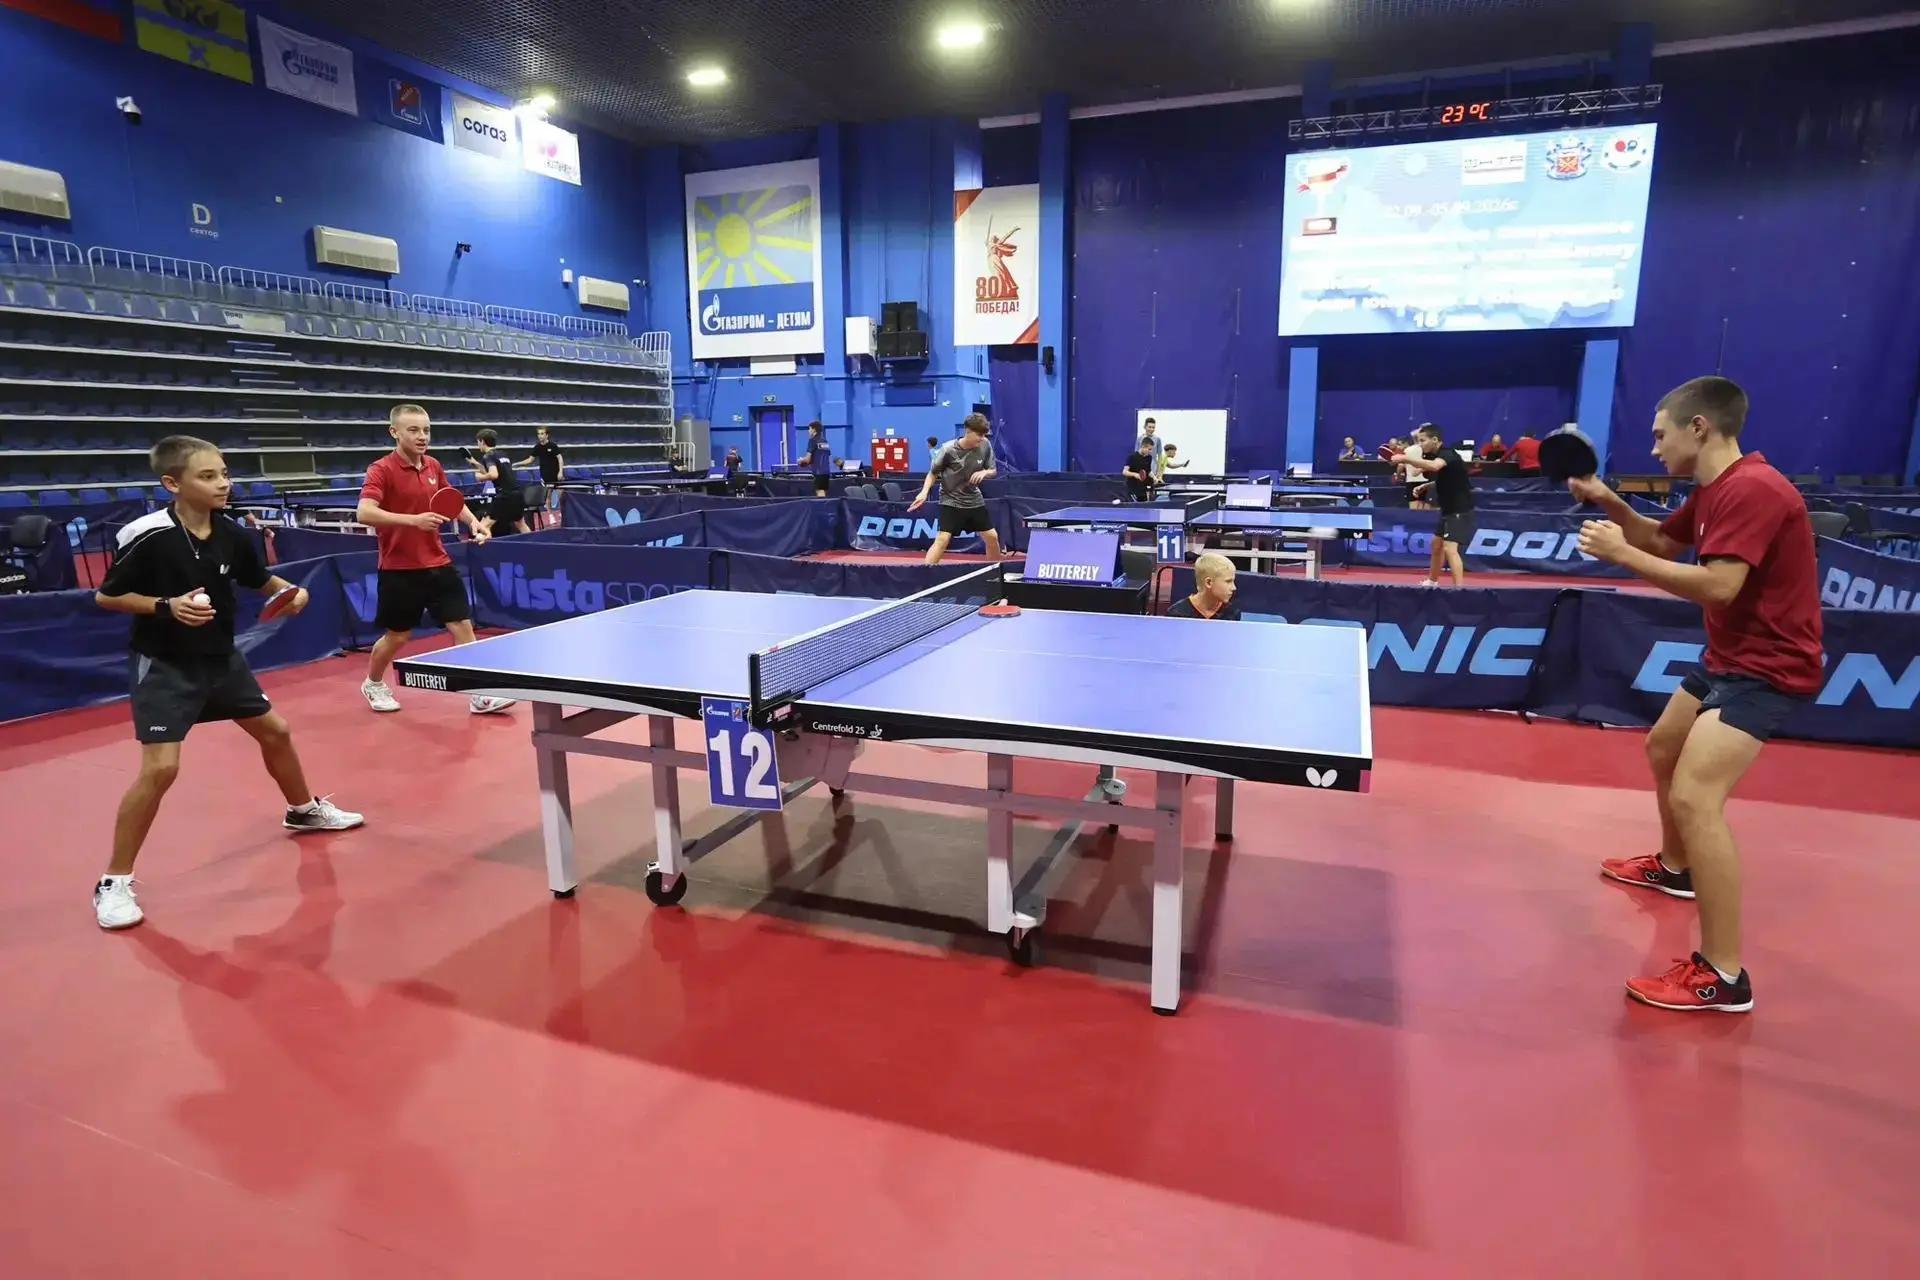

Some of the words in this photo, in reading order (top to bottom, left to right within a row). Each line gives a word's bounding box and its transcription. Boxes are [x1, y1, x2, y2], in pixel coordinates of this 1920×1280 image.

[1442, 105, 1465, 123] 23
[192, 203, 211, 225] D
[975, 275, 999, 298] 80
[975, 301, 1020, 315] ПОБЕДА!
[720, 313, 765, 331] ГАЗПРОМ
[776, 310, 811, 330] ДЕТЯМ
[856, 515, 976, 540] DON
[1158, 535, 1181, 559] 11
[1465, 528, 1600, 561] DON
[1038, 563, 1100, 581] BUTTERFLY
[1821, 567, 1920, 613] DON
[405, 672, 447, 690] BUTTERFLY
[812, 721, 854, 734] Centrefold
[855, 726, 865, 735] 25
[709, 729, 777, 799] 12
